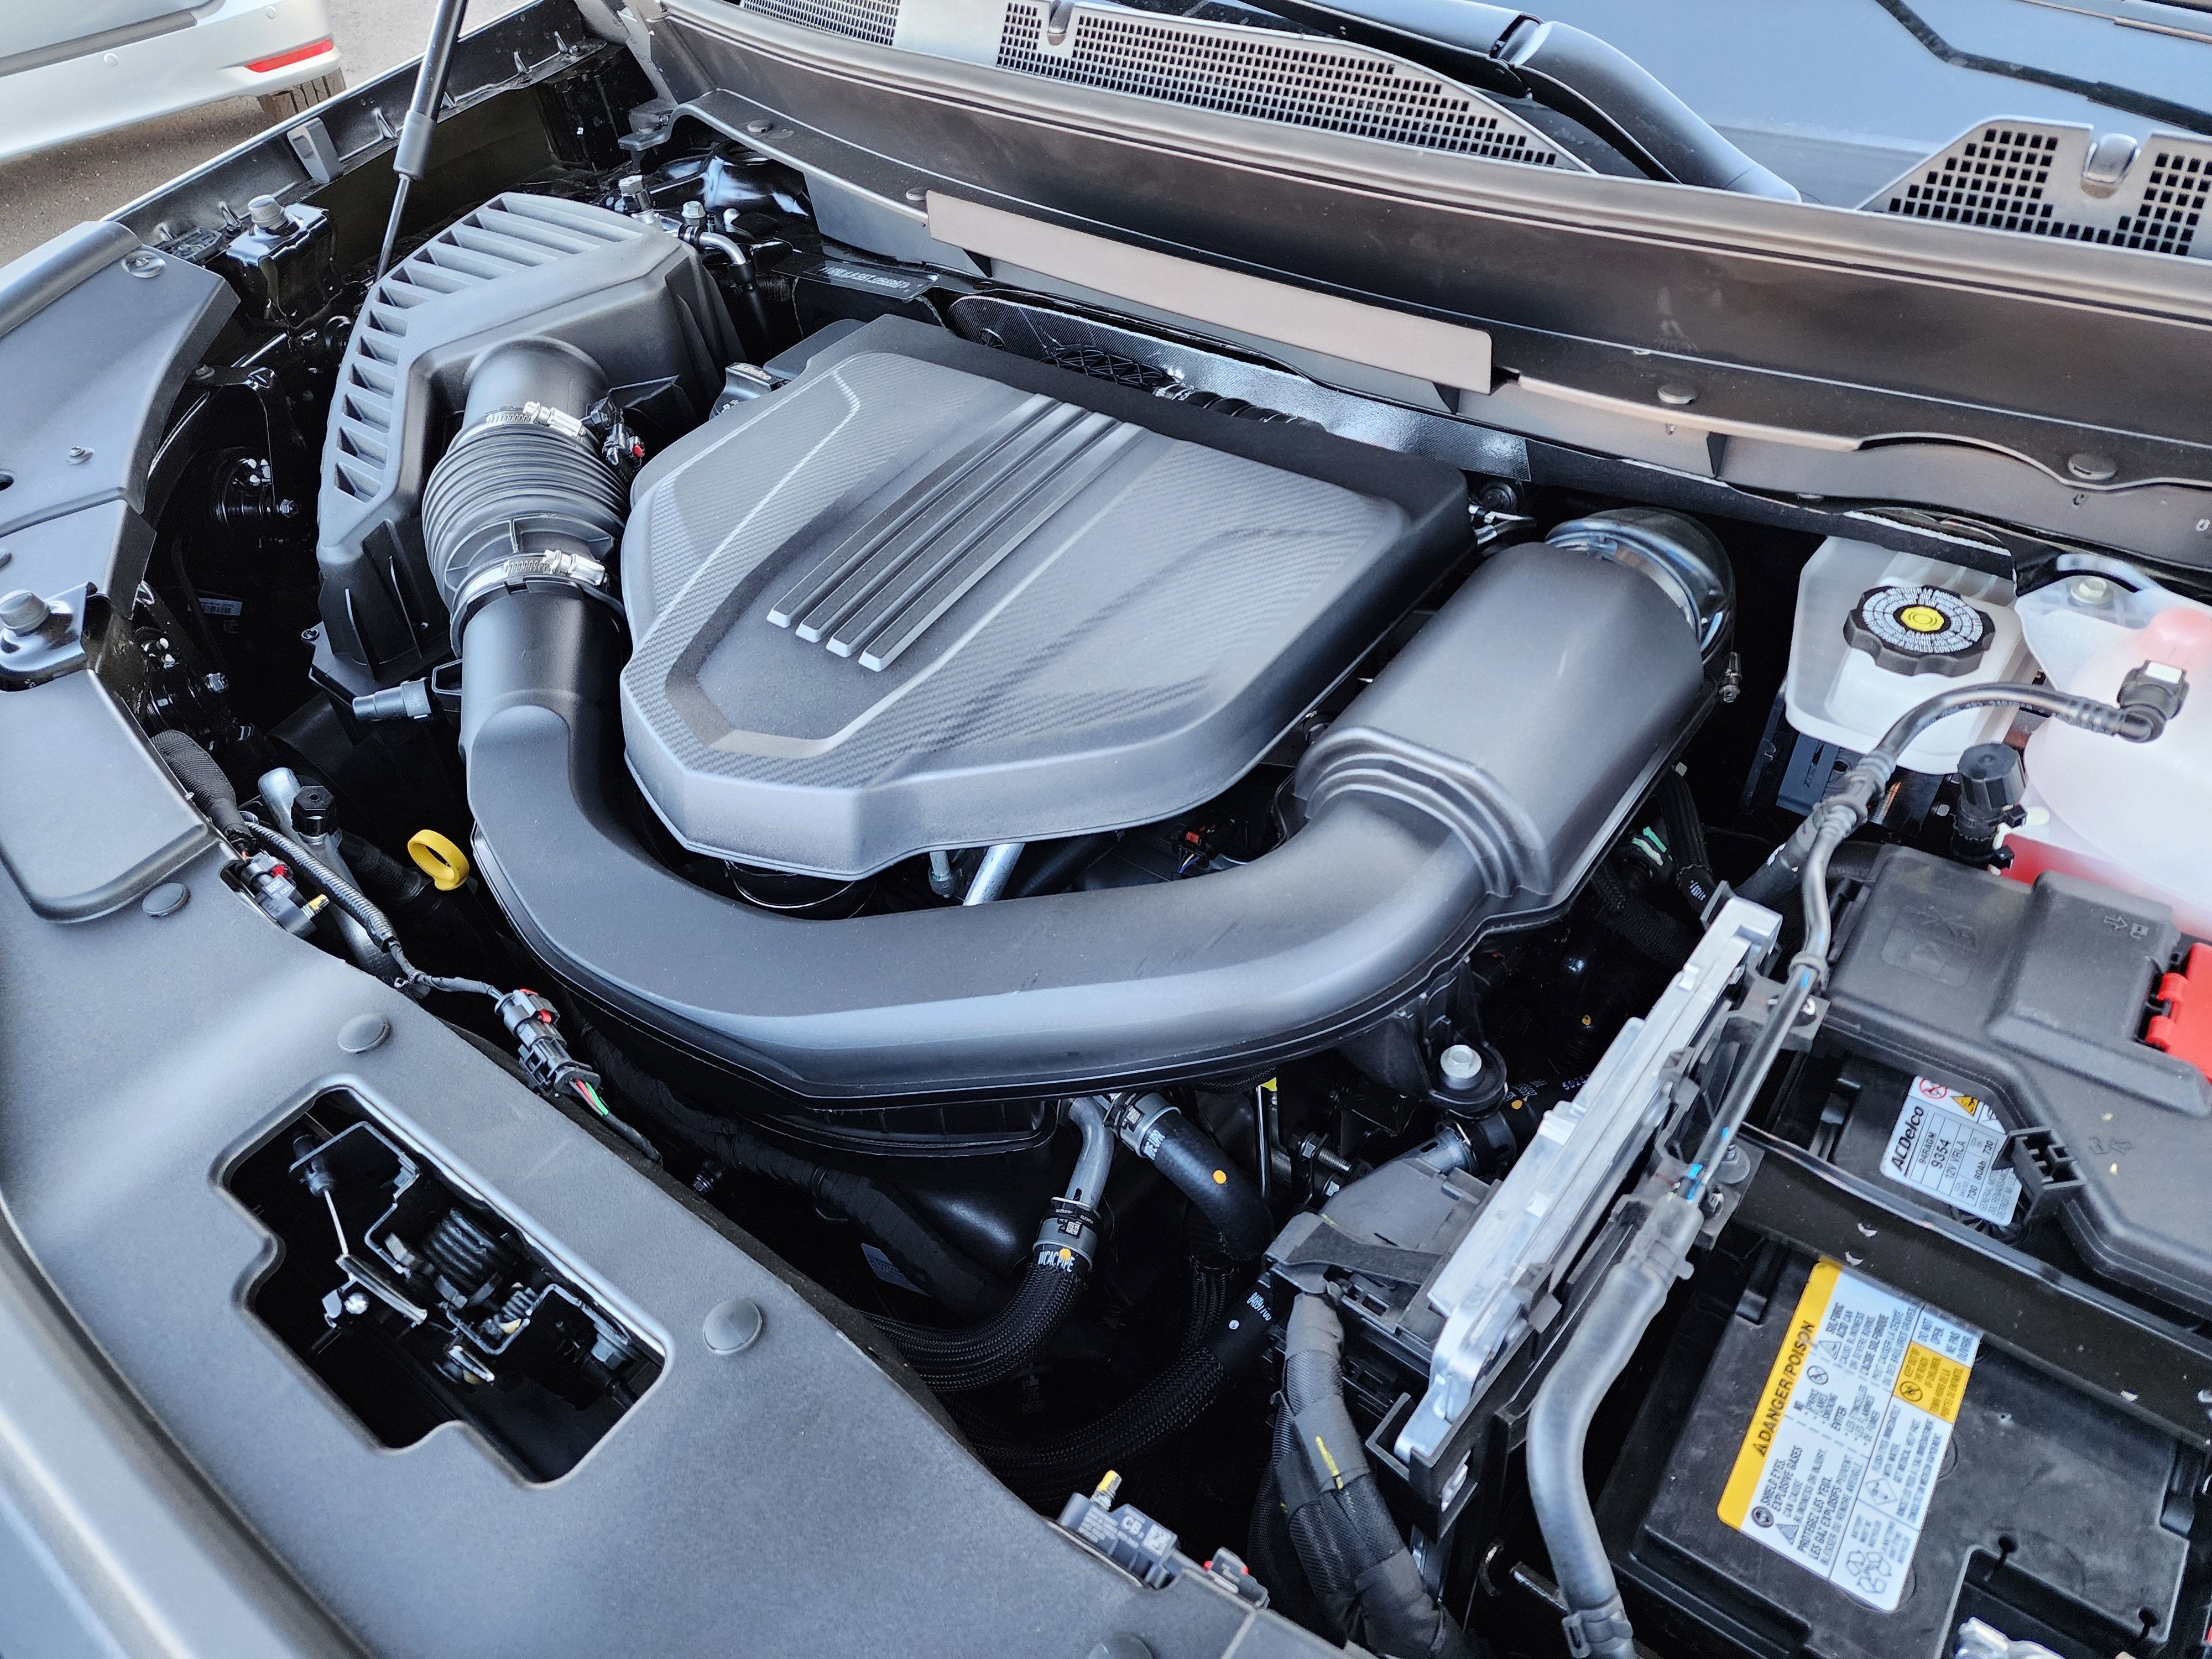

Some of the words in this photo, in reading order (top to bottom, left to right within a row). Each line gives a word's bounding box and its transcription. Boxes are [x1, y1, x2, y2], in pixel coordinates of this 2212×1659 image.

[1891, 1105, 1924, 1171] ACDelco
[1918, 1130, 1937, 1165] 94RAGM
[1982, 1139, 1994, 1156] 730
[1930, 1137, 1951, 1170] 9354
[1950, 1138, 1966, 1164] VRLA
[1944, 1163, 1958, 1181] 12V
[1973, 1159, 1986, 1181] 80Ah
[1986, 1168, 1999, 1186] MOTO
[1966, 1184, 1978, 1201] 730
[1825, 1301, 1845, 1334] SULFURIC
[1841, 1309, 1854, 1323] CAN
[1921, 1317, 1933, 1332] NOT
[1835, 1322, 1849, 1339] ACID
[1867, 1313, 1888, 1352] SULFURIQUE
[1917, 1331, 1929, 1342] DO
[1948, 1331, 1961, 1345] PAS
[1945, 1343, 1957, 1355] NE
[1756, 1319, 1816, 1444] DANGER/POISON
[1771, 1469, 1793, 1512] EXPLOSIVE
[1786, 1444, 1803, 1470] GASES
[1760, 1477, 1778, 1506] SHIELD
[1811, 1496, 1824, 1514] LES
[1820, 1484, 1843, 1527] EXPLOSIFS
[1814, 1525, 1828, 1545] GAZ
[1808, 1542, 1822, 1561] LES
